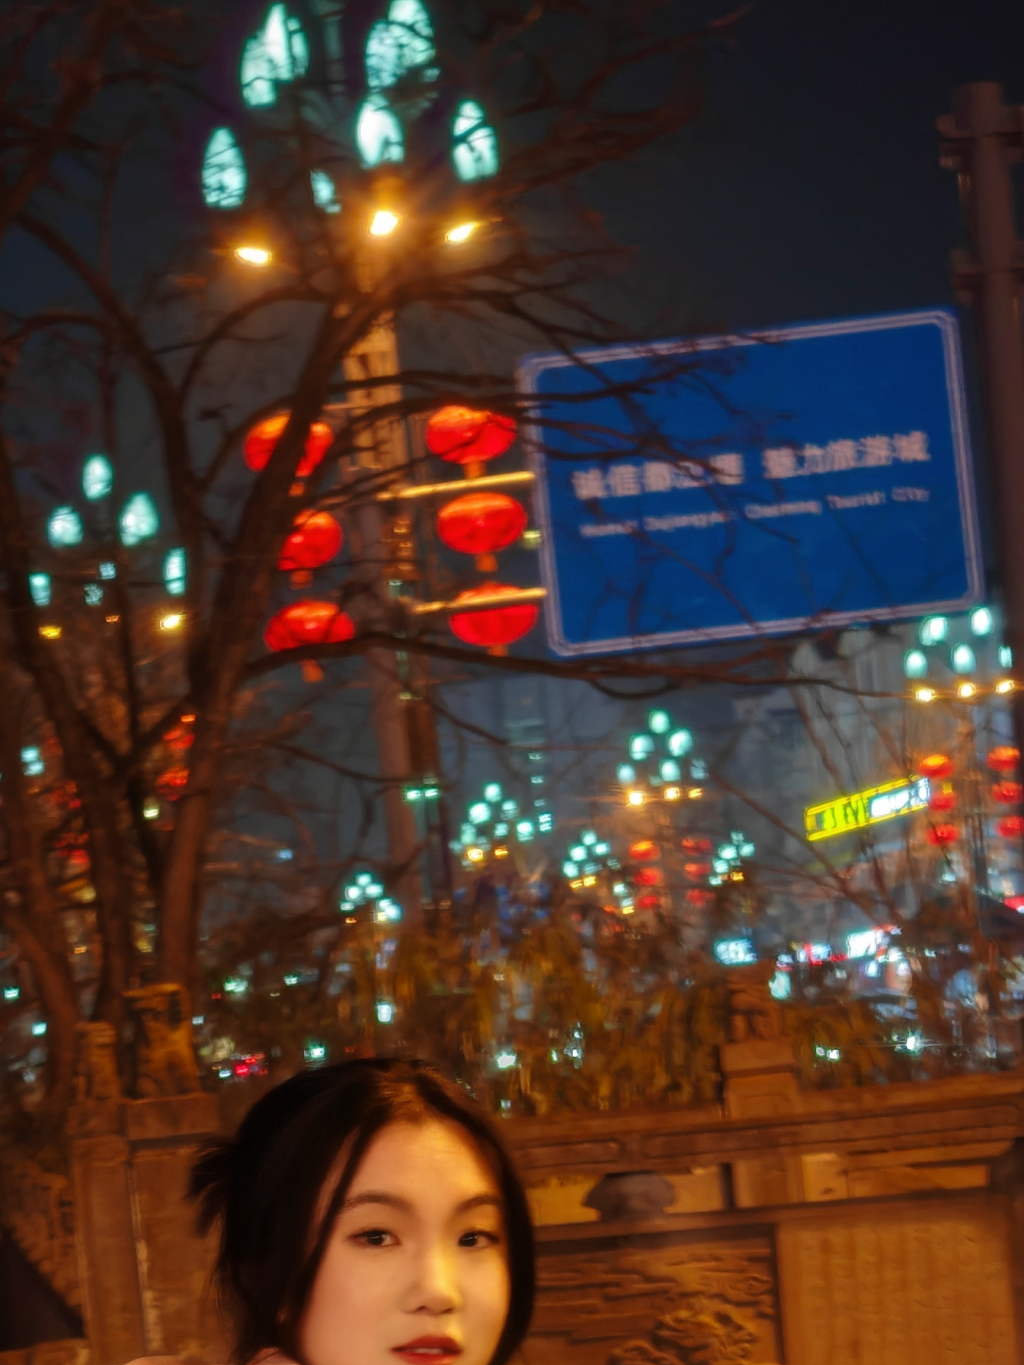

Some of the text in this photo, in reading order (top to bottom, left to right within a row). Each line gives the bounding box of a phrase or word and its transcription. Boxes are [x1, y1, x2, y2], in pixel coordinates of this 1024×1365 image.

[763, 430, 931, 479] 魅力旅游城
[744, 500, 822, 521] Charming
[826, 491, 886, 511] Tourist
[891, 486, 931, 502] City
